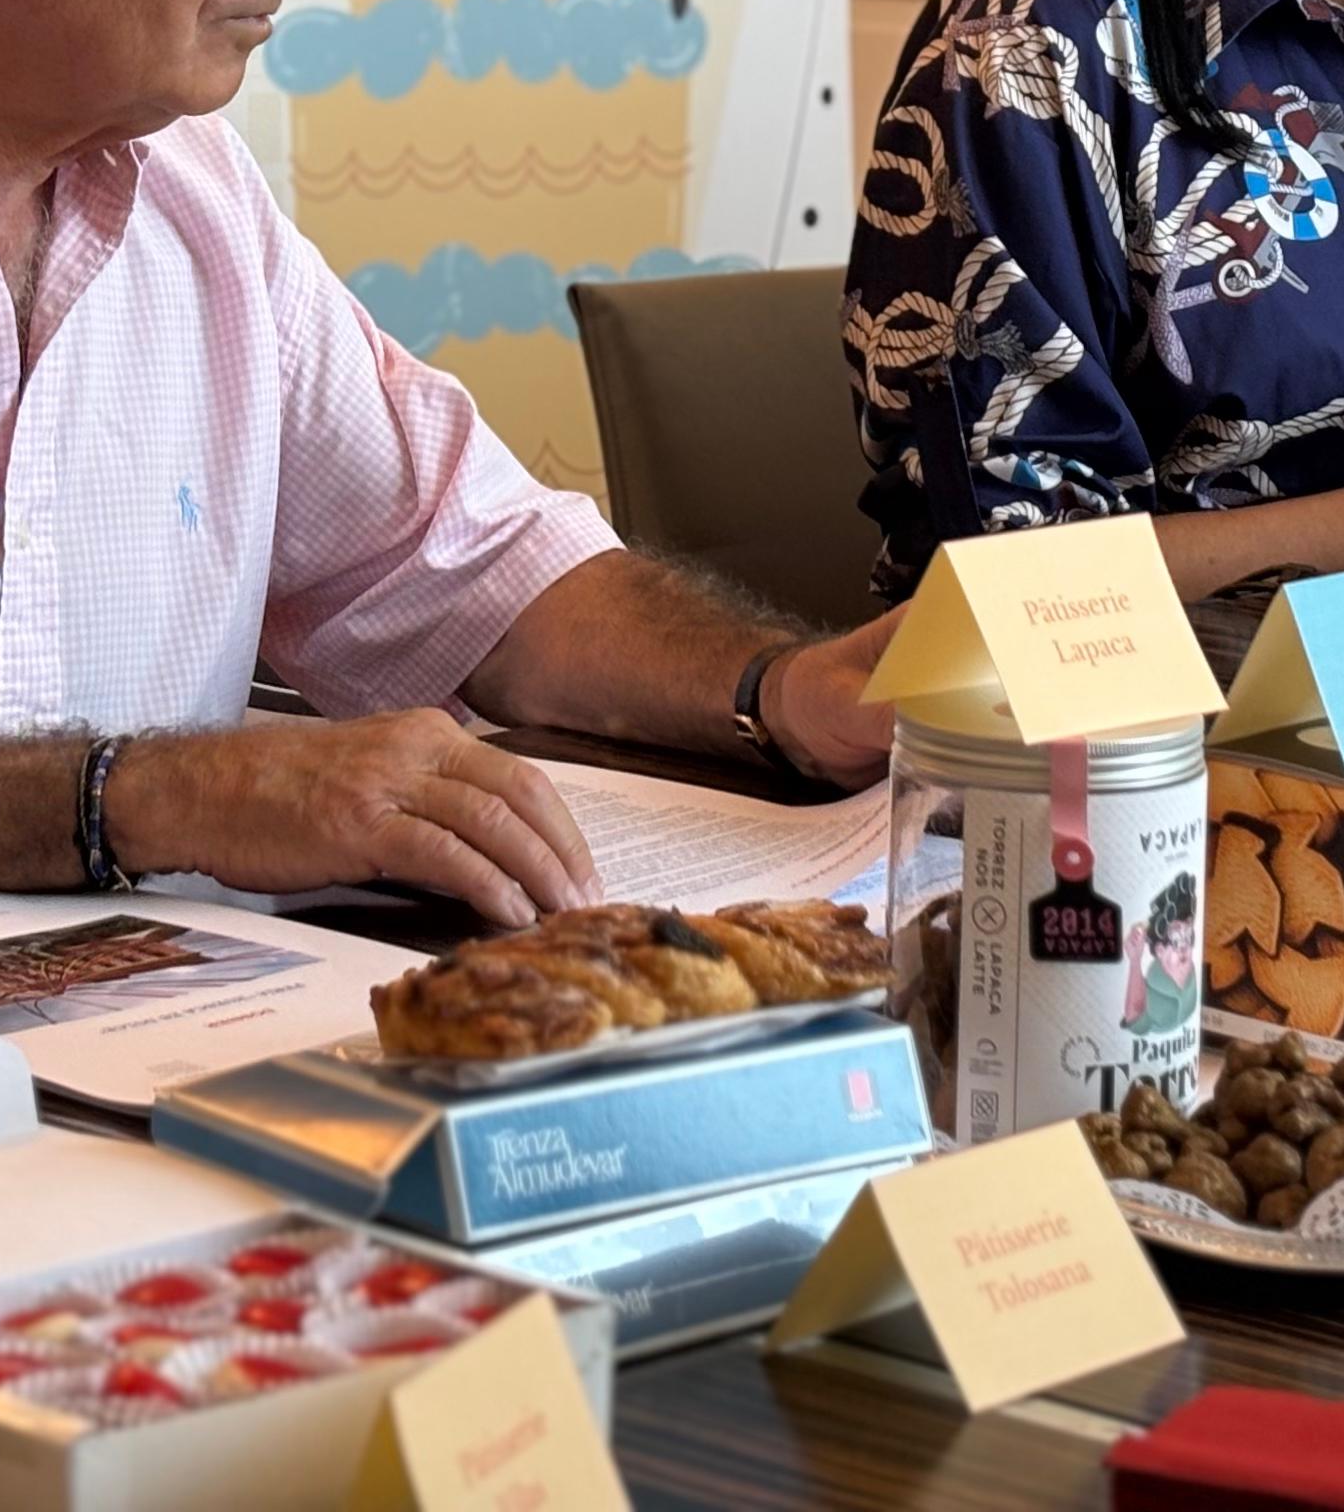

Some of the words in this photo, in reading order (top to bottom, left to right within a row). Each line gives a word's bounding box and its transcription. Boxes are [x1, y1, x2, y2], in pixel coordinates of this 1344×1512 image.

[1022, 586, 1131, 626] Pâtisserie
[1051, 635, 1137, 668] Lapaca
[975, 848, 988, 888] NOS
[973, 940, 986, 996] LATTE
[989, 941, 1003, 1016] LAPACA
[486, 1125, 572, 1162] Trenza
[954, 1207, 1073, 1269] Pâtisserie
[977, 1260, 1094, 1314] Tolosana
